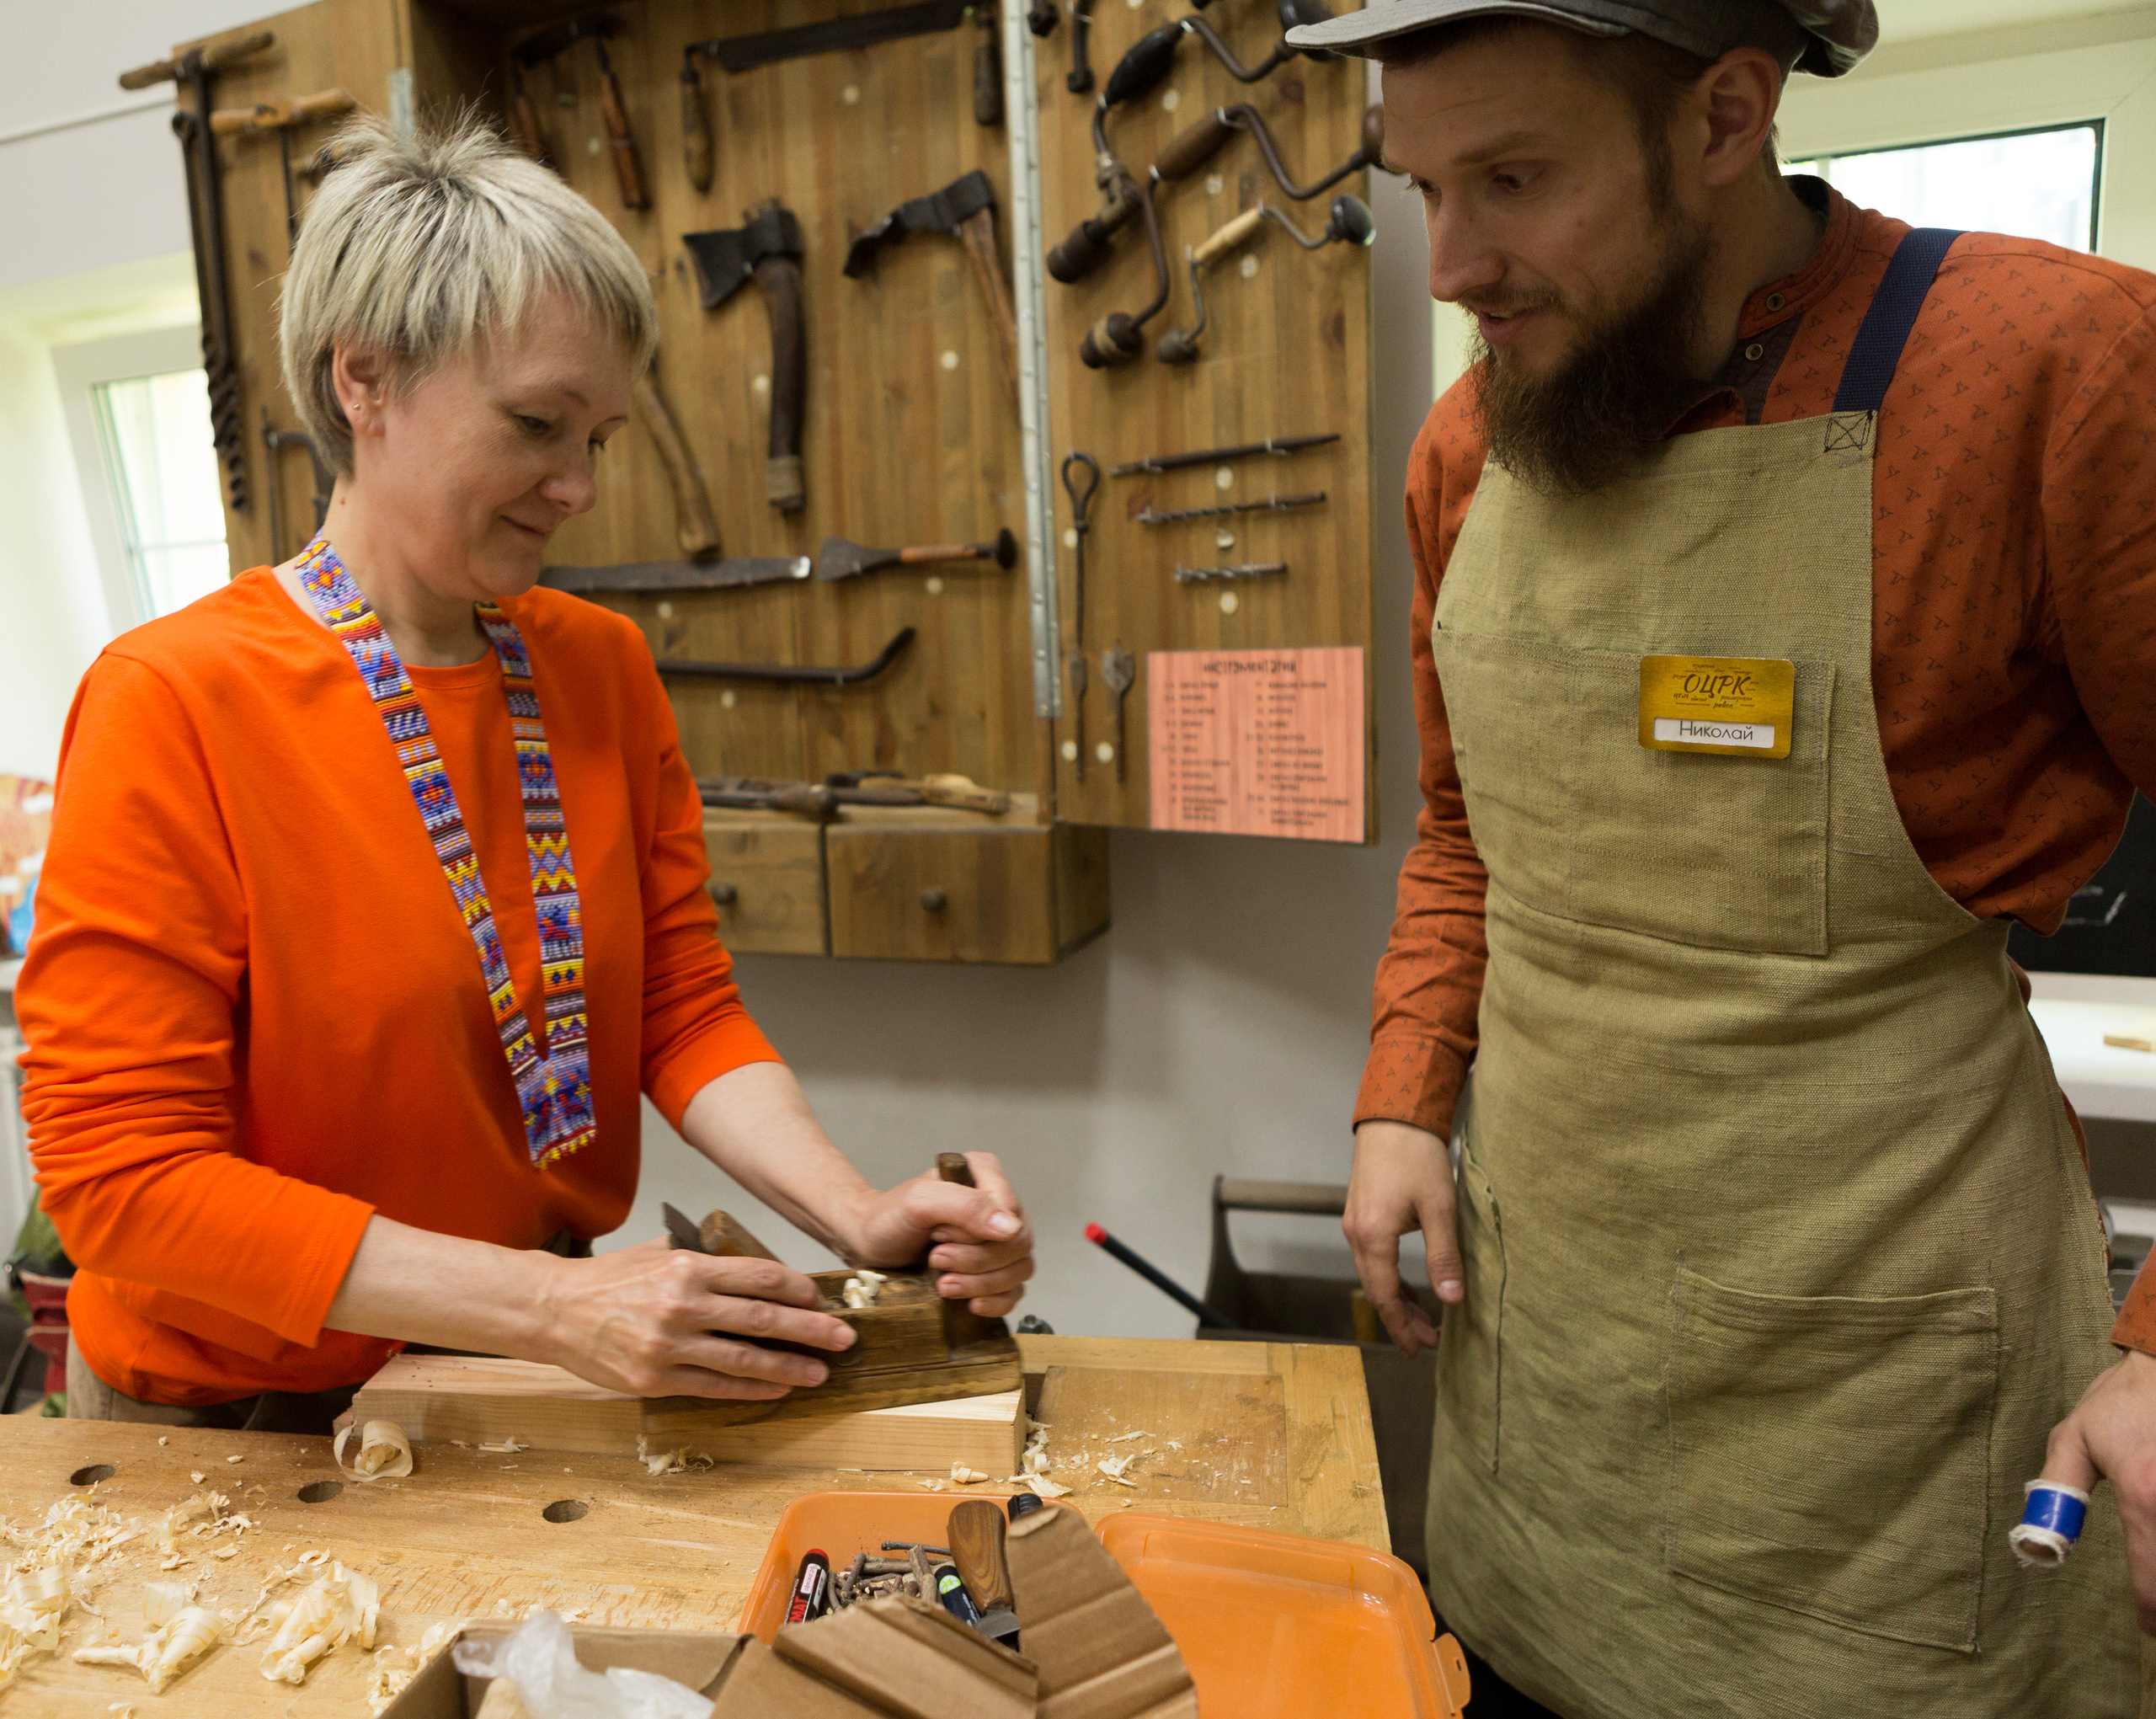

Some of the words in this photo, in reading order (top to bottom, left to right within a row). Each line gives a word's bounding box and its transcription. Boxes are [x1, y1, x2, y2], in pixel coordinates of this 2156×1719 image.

[1684, 673, 1752, 698] ОЦРК
[1679, 720, 1753, 740] Николай
[789, 1597, 808, 1623] МАГ
